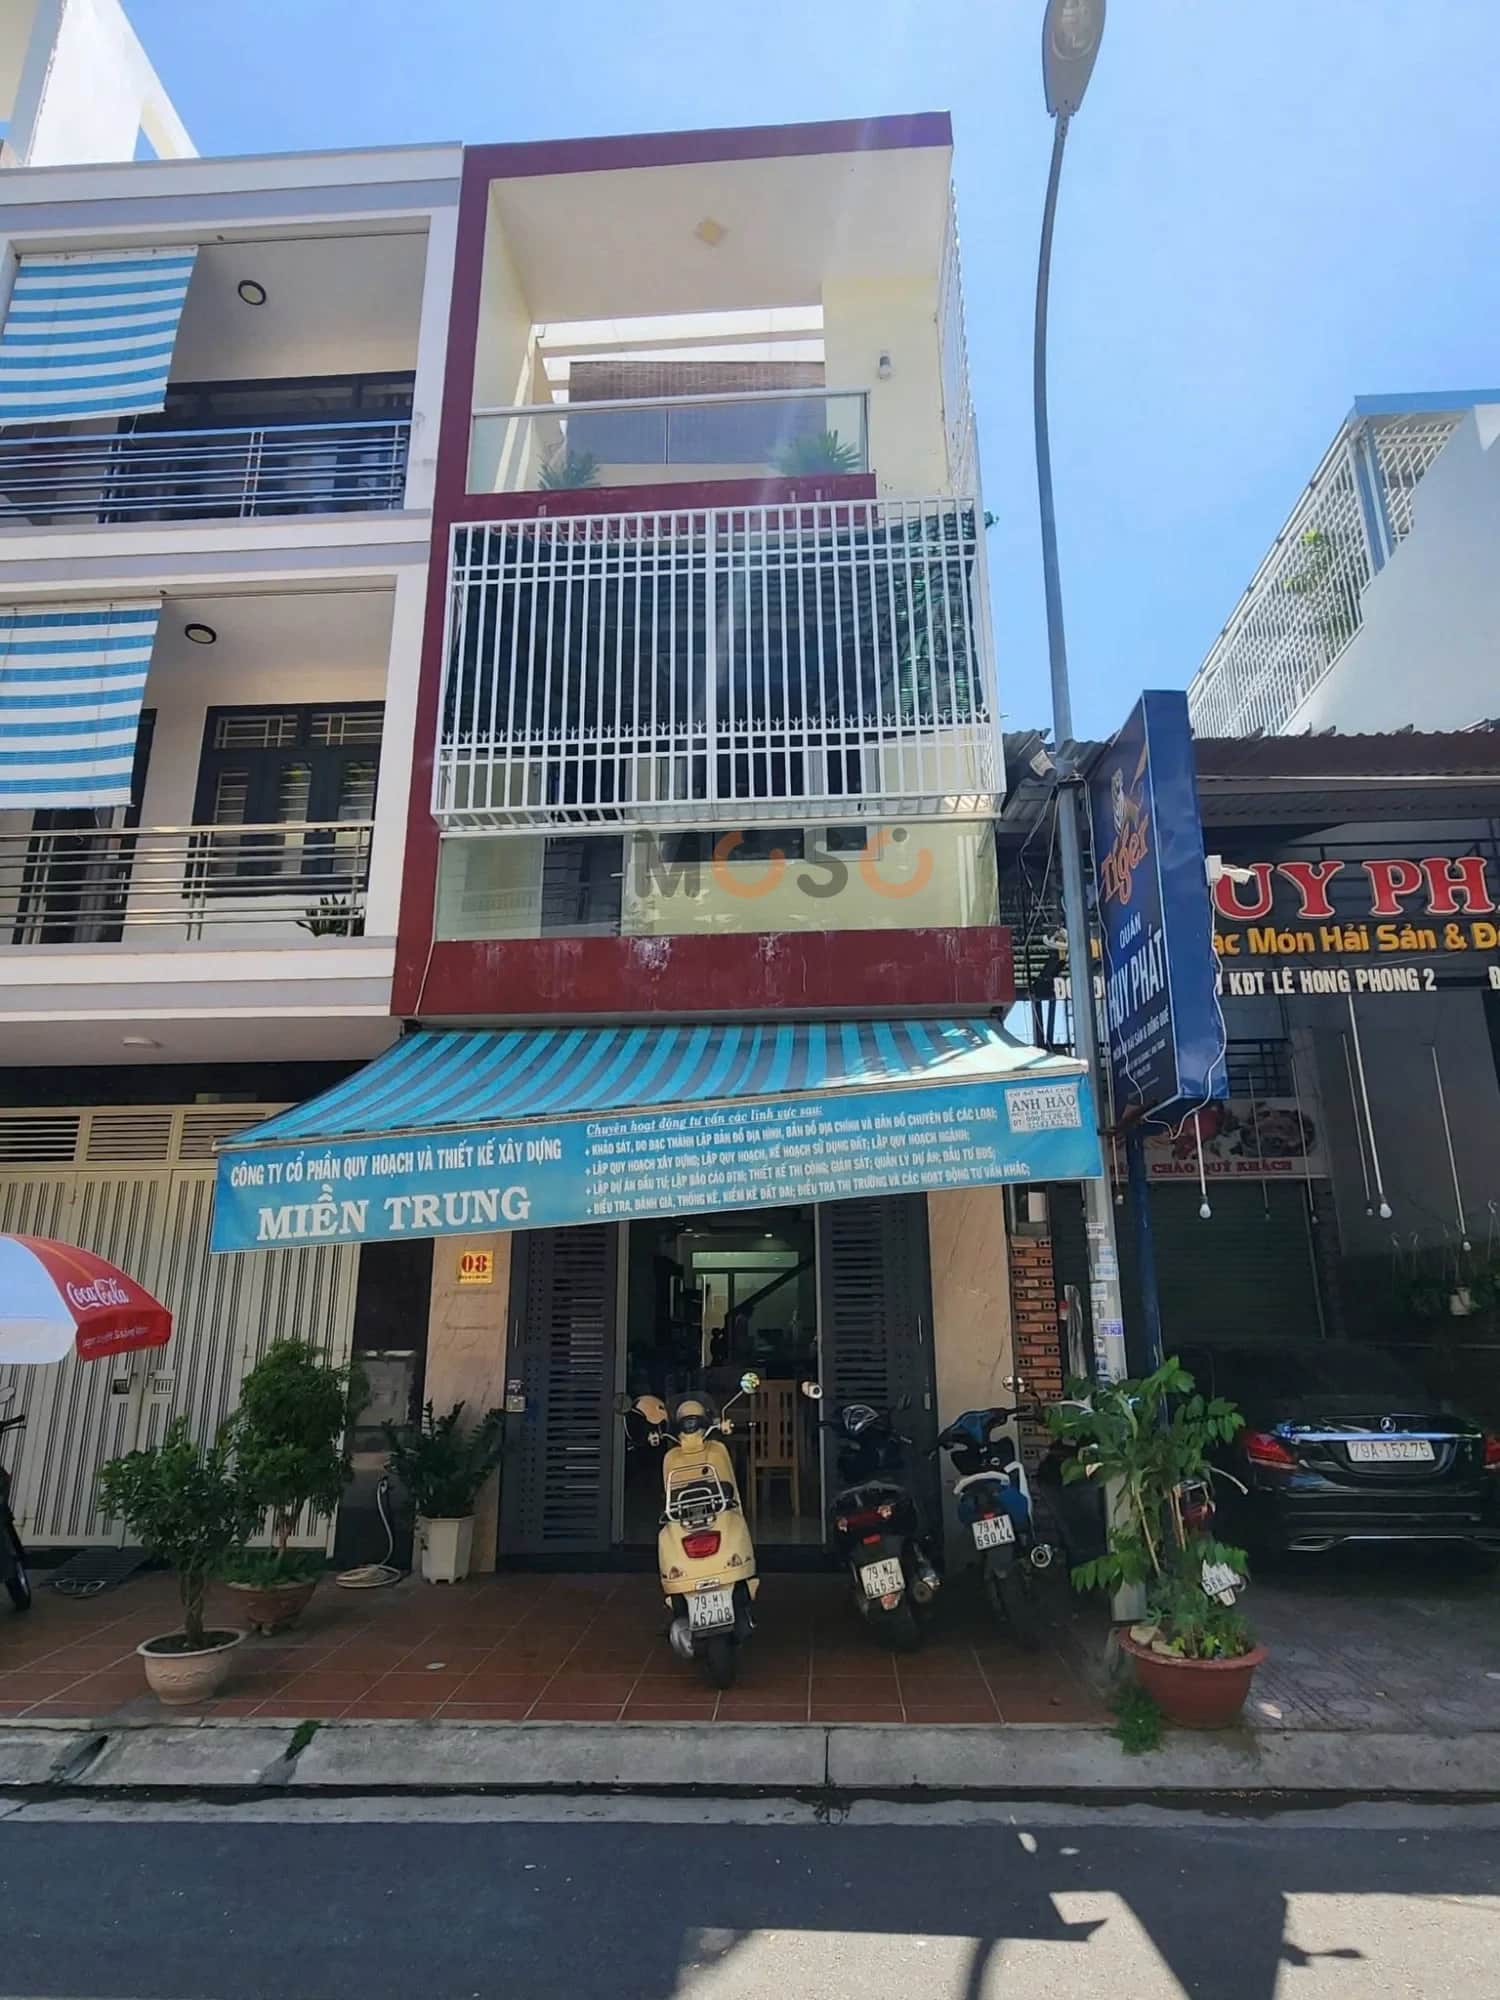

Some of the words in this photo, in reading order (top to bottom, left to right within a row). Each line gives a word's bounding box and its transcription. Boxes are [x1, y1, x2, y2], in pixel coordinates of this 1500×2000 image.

[1101, 814, 1149, 904] Tiger
[1362, 856, 1500, 917] PH
[1248, 926, 1316, 954] Món
[1320, 923, 1369, 952] Hải
[1376, 923, 1436, 952] Sản
[1444, 922, 1467, 951] &
[1471, 921, 1500, 950] Đ
[1107, 963, 1130, 1031] HUY
[1130, 923, 1164, 1012] PHÁT
[1271, 967, 1295, 995] LÊ
[1356, 967, 1420, 993] PHONG
[1424, 968, 1437, 991] 2
[729, 1112, 747, 1123] các
[861, 1116, 873, 1130] VÀ
[908, 1108, 941, 1126] CHUYÊN
[956, 1106, 974, 1122] CÁC
[1012, 1098, 1040, 1112] ANH
[231, 1160, 264, 1187] CÔNG
[267, 1163, 283, 1184] TY
[286, 1151, 305, 1182] CỔ
[307, 1150, 340, 1180] PHẦN
[343, 1155, 369, 1180] QUY
[371, 1150, 414, 1178] HOẠCH
[417, 1145, 433, 1171] VÀ
[437, 1139, 474, 1170] THIẾT
[477, 1137, 496, 1167] KẾ
[498, 1137, 523, 1165] XÂY
[526, 1136, 562, 1165] DỰNG
[609, 1161, 626, 1175] QUY
[657, 1154, 673, 1168] XÂY
[719, 1151, 736, 1165] QUY
[889, 1134, 906, 1149] QUY
[901, 1168, 920, 1185] CÁC
[256, 1183, 369, 1241] MIỀN
[384, 1185, 532, 1231] TRUNG
[461, 1254, 488, 1273] 08
